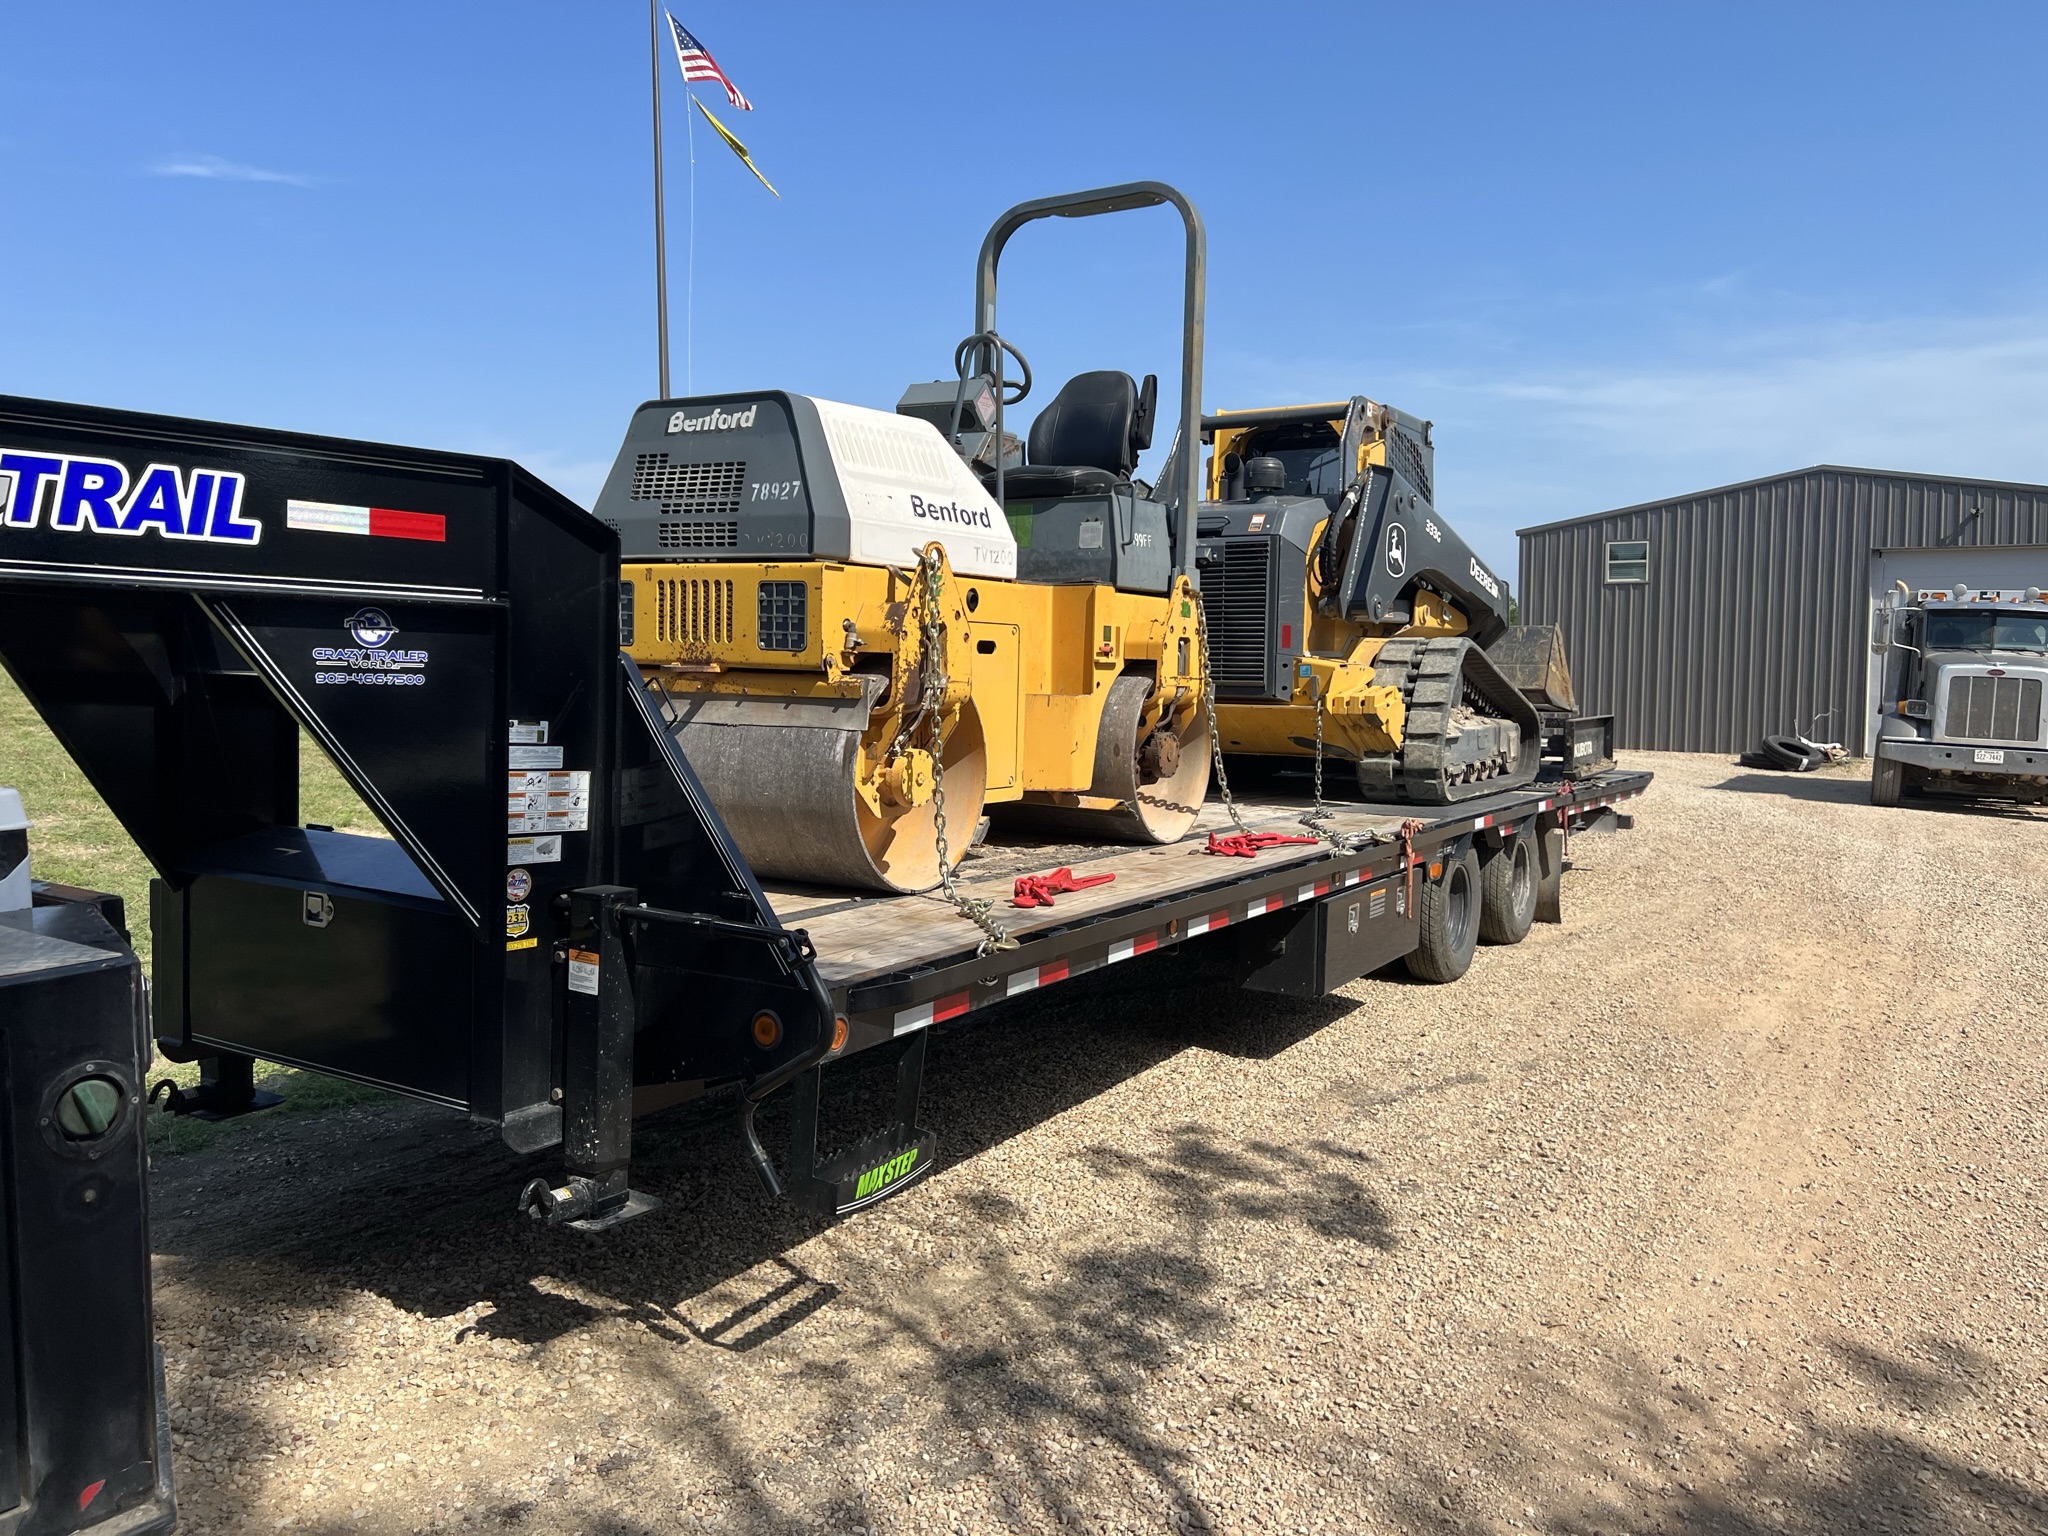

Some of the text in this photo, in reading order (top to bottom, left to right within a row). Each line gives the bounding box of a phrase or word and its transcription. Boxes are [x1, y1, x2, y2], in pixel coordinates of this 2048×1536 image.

[667, 405, 758, 433] Benford
[0, 448, 262, 546] TRAIL
[751, 480, 801, 502] 78927
[910, 494, 992, 529] Benford
[974, 546, 1014, 567] TV1200
[312, 647, 428, 662] CRAZY TRAILER
[349, 660, 393, 670] WORLD
[315, 672, 426, 686] 903-466-7500
[1573, 740, 1593, 759] KUBOTA
[508, 913, 526, 923] 232
[855, 1148, 919, 1200] MAXSTEP
